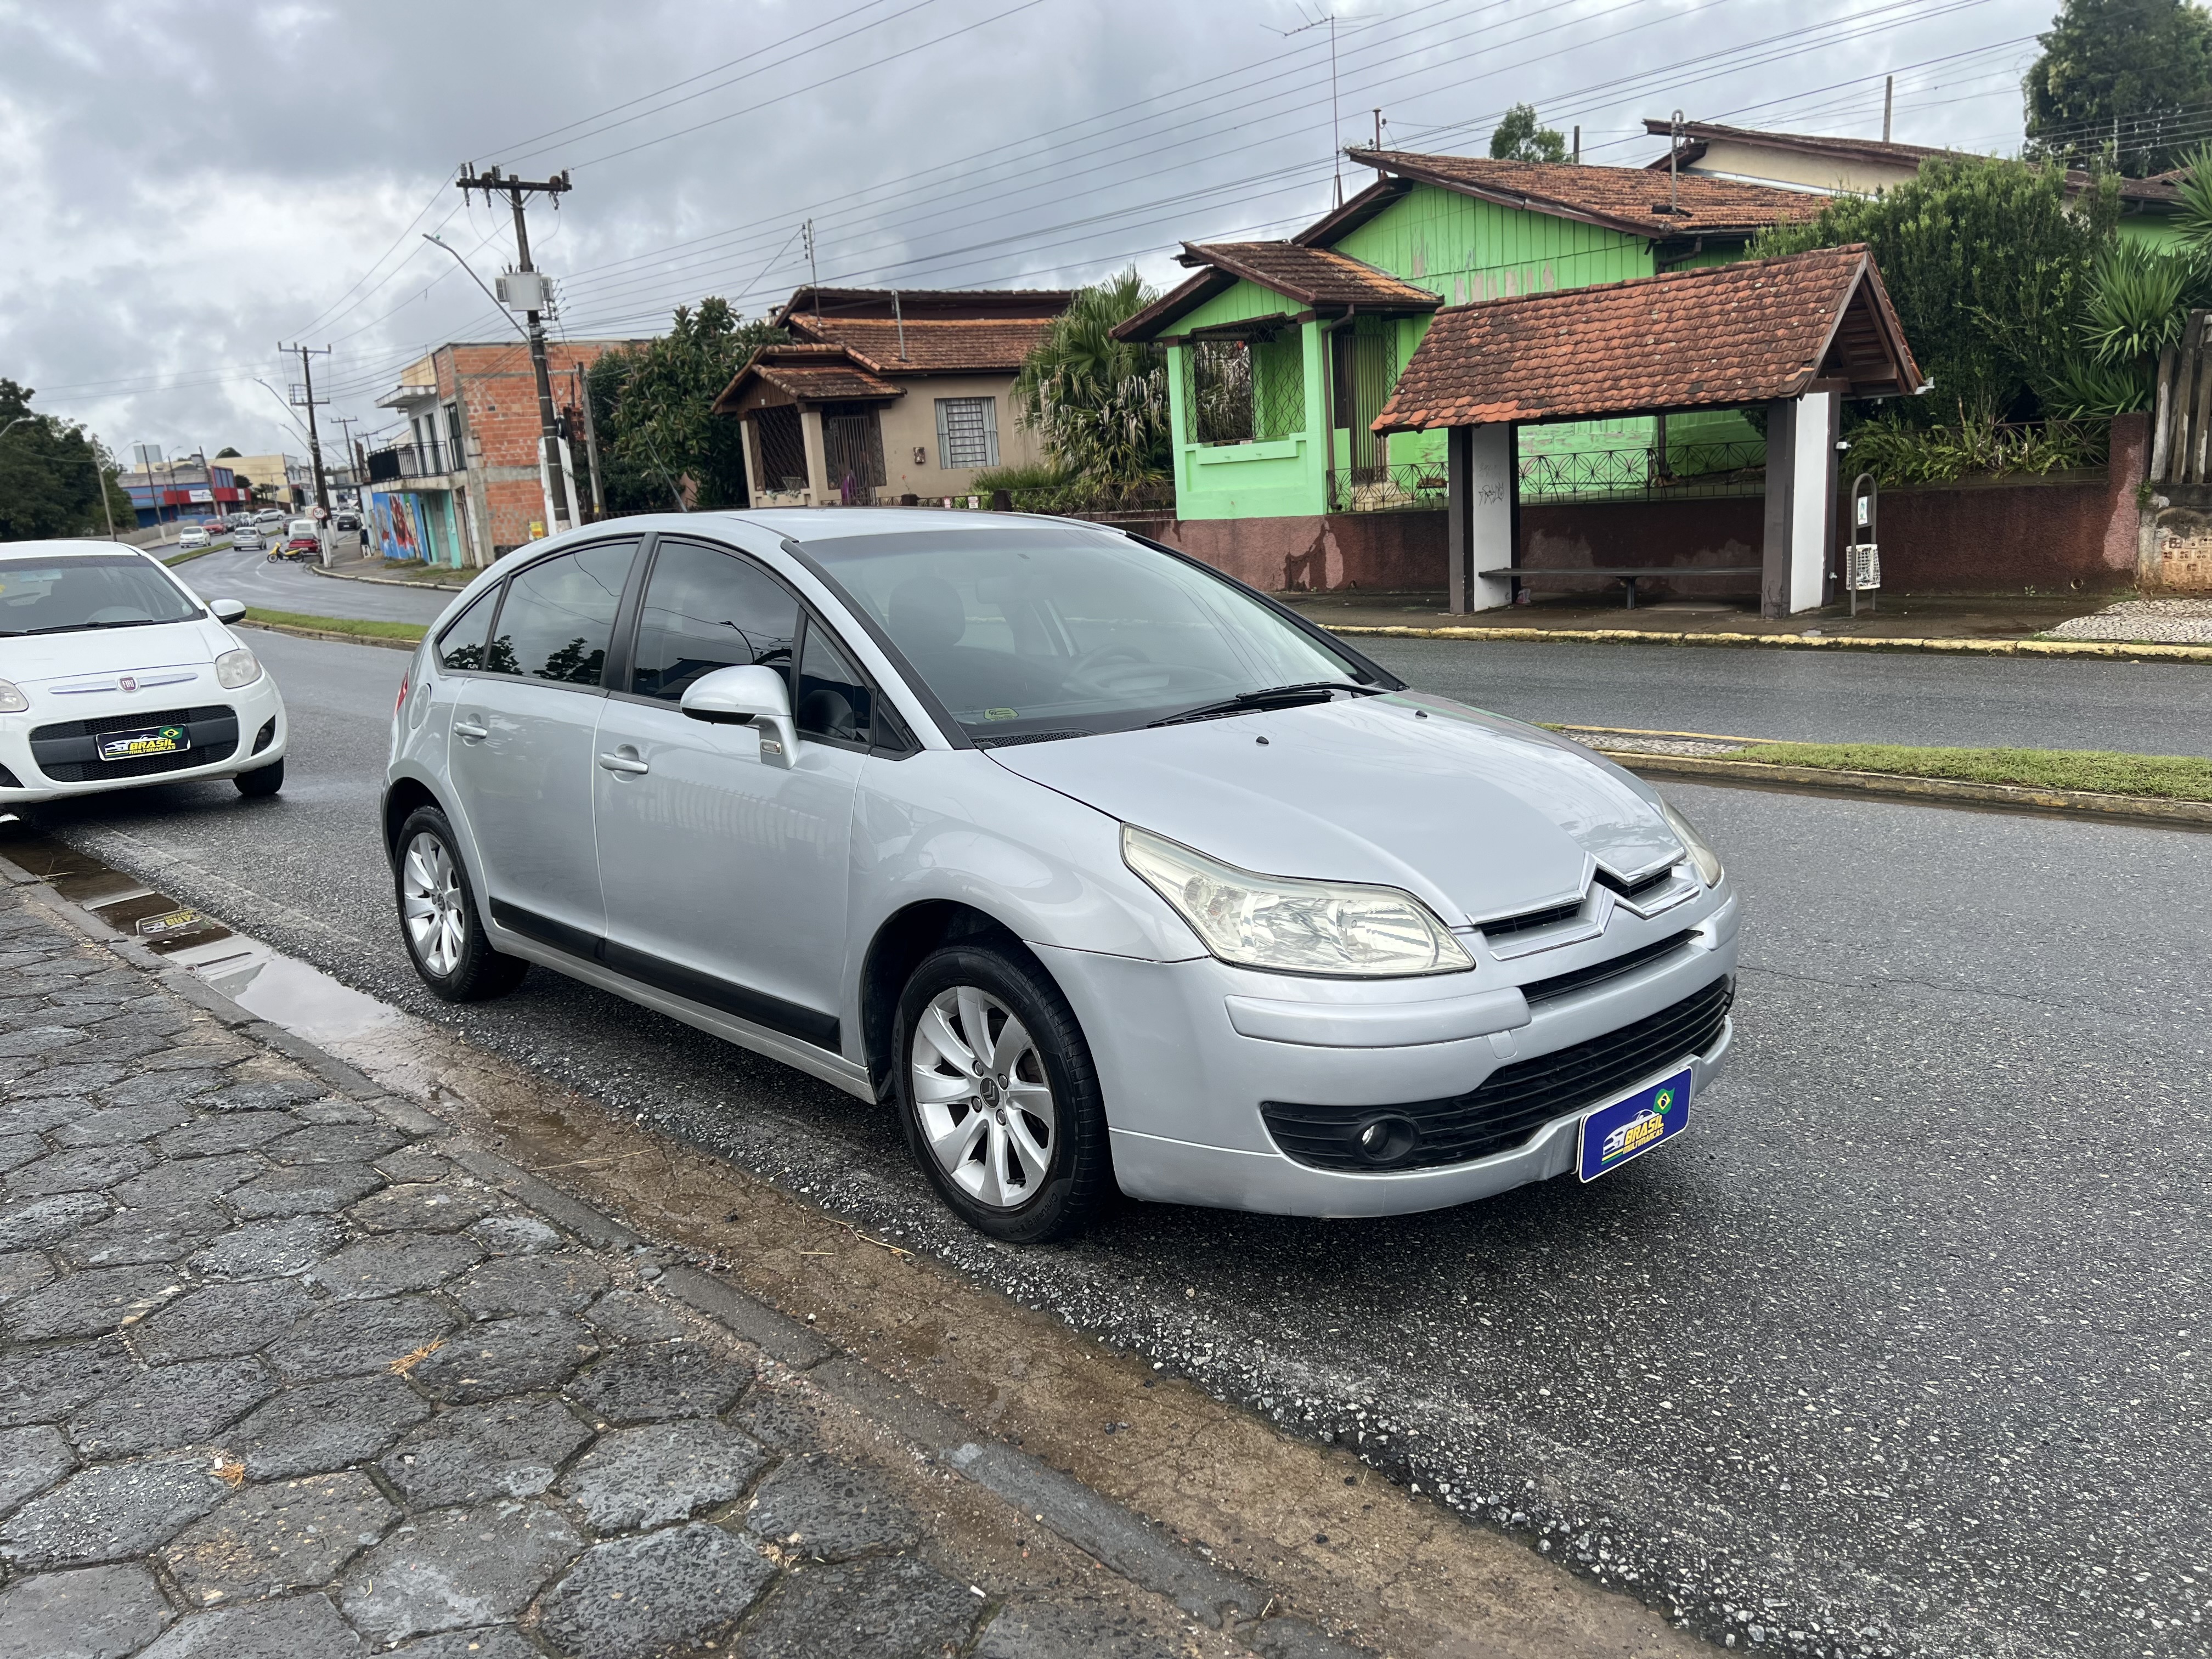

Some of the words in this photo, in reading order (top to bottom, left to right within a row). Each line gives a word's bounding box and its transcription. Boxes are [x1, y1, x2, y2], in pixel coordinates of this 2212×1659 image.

[122, 680, 135, 688] FIAT
[129, 739, 176, 751] BRASIL
[129, 746, 176, 754] MULTIMARCAS
[1624, 1115, 1664, 1146] BRASIL
[1622, 1127, 1664, 1154] MULTIMARCAS
